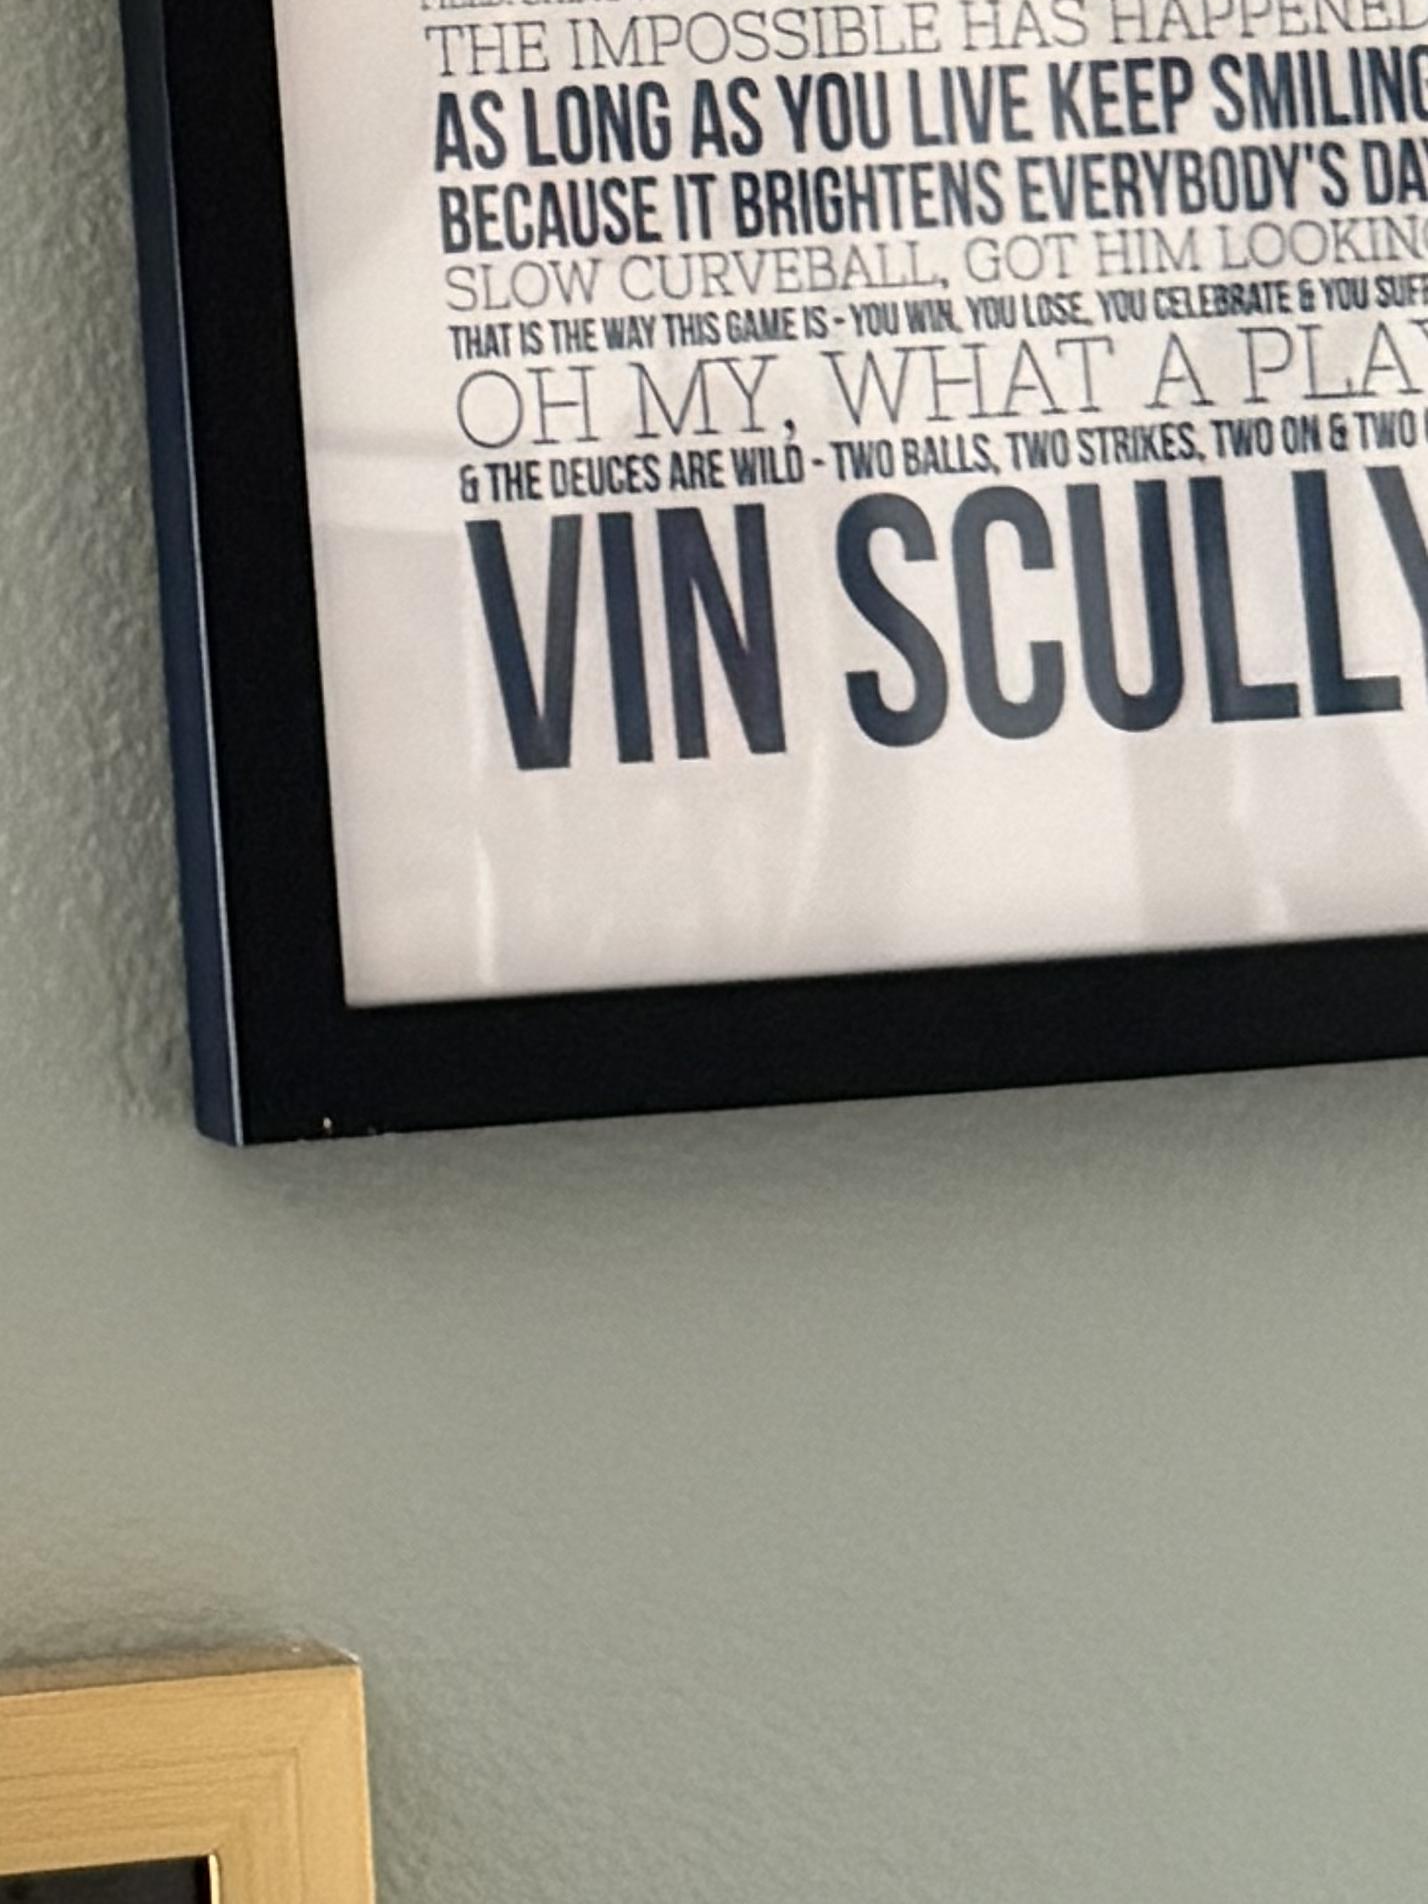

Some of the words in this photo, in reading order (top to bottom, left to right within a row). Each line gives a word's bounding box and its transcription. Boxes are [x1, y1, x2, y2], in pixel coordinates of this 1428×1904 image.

[423, 18, 551, 79] THE
[566, 0, 943, 72] IMPOSSIBLE
[428, 88, 509, 173] AS
[520, 79, 674, 168] LONG
[685, 75, 765, 160] AS
[776, 68, 893, 155] YOU
[905, 61, 1033, 148] LIVE
[1046, 53, 1198, 141] KEEP
[436, 174, 662, 256] BECAUSE
[671, 171, 719, 243] IT
[728, 156, 1006, 239] BRIGHTENS
[1015, 138, 1351, 225] EVERYBODY'S
[442, 256, 606, 314] SLOW
[961, 230, 1081, 285] GOT
[1091, 223, 1202, 278] HIM
[1215, 211, 1427, 272] LOOKIN
[449, 320, 513, 361] THAT
[517, 319, 545, 357] IS
[549, 316, 598, 355] THE
[601, 312, 658, 352] WAY
[663, 309, 722, 349] THIS
[723, 304, 798, 345] GAME
[801, 303, 829, 341] IS
[849, 299, 901, 338] YOU
[965, 292, 1018, 332] YOU
[452, 362, 601, 452] OH
[820, 333, 1120, 429] WHAT
[1139, 329, 1215, 410] A
[485, 458, 543, 503] THE
[547, 451, 662, 500] DEUCES
[666, 446, 725, 492] ARE
[729, 442, 806, 488] WILD
[831, 436, 896, 482] TWO
[1006, 426, 1072, 472] TWO
[1210, 414, 1276, 459] TWO
[1279, 412, 1323, 455] ON
[1354, 406, 1419, 450] TWO
[468, 500, 787, 774] VIN
